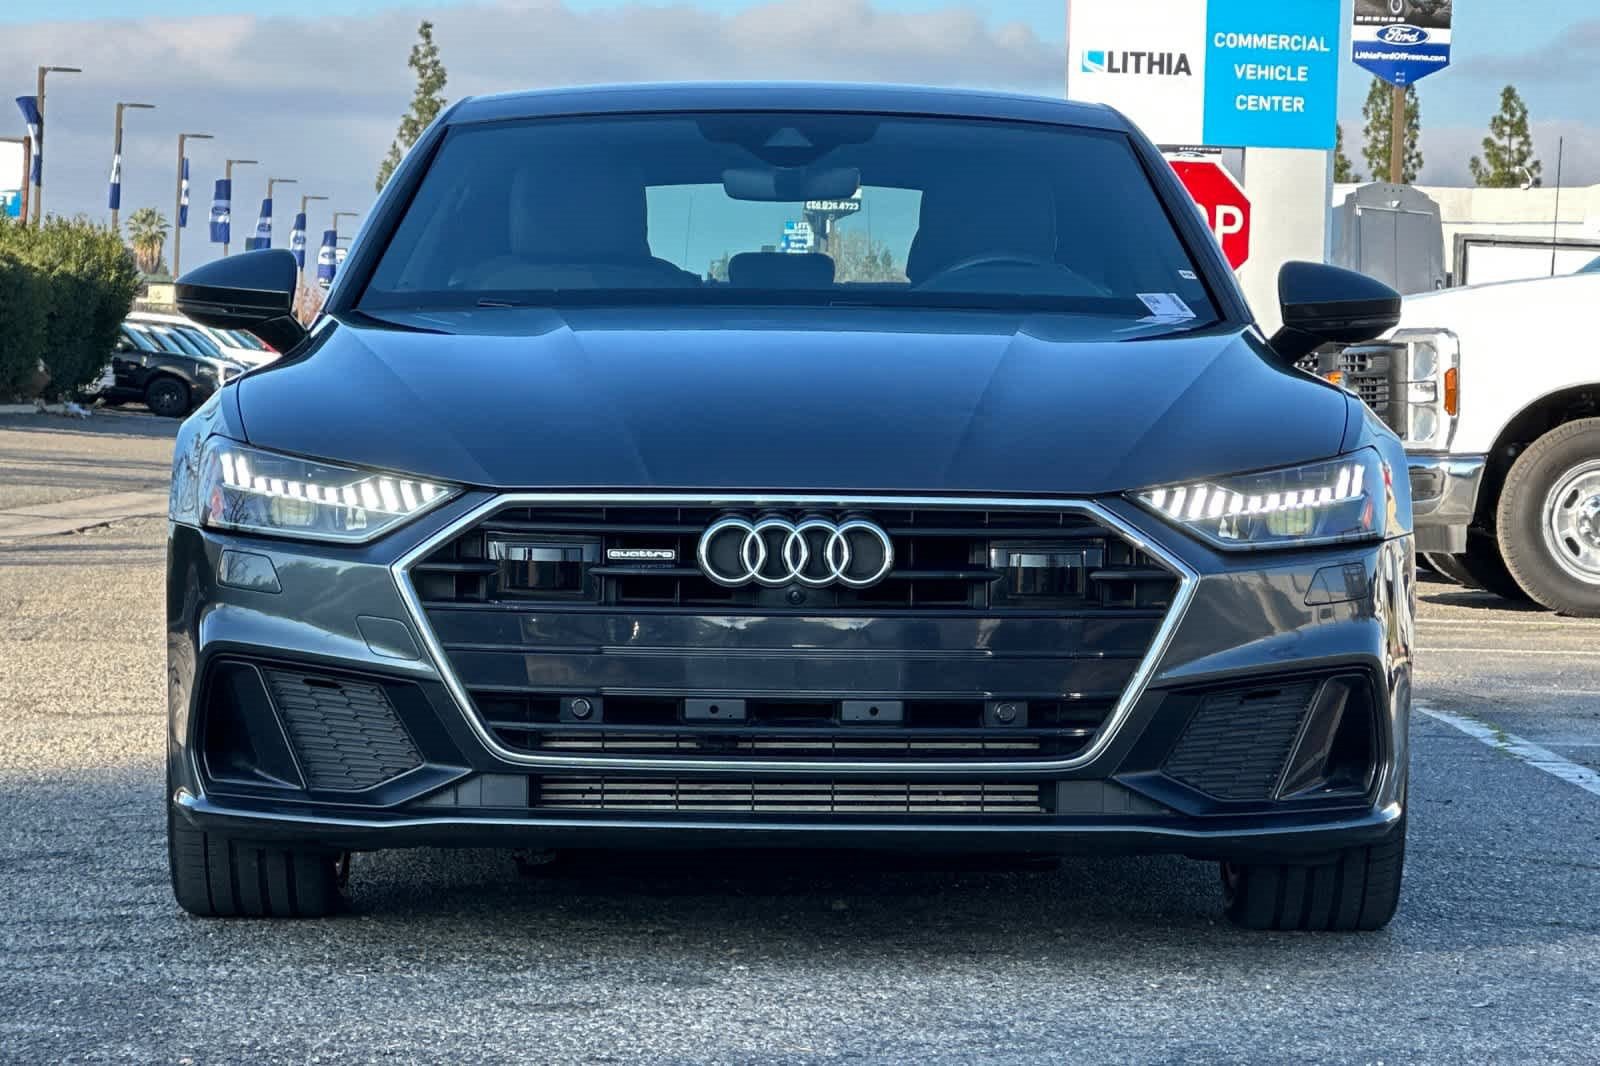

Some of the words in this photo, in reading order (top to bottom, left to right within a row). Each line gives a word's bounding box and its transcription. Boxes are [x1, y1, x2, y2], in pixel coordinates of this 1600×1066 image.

[1214, 32, 1330, 52] COMMERCIAL
[1384, 27, 1419, 42] Ford
[1107, 51, 1192, 76] LITHIA
[1234, 64, 1308, 81] VEHICLE
[1235, 95, 1305, 112] CENTER
[610, 550, 673, 558] quattro
